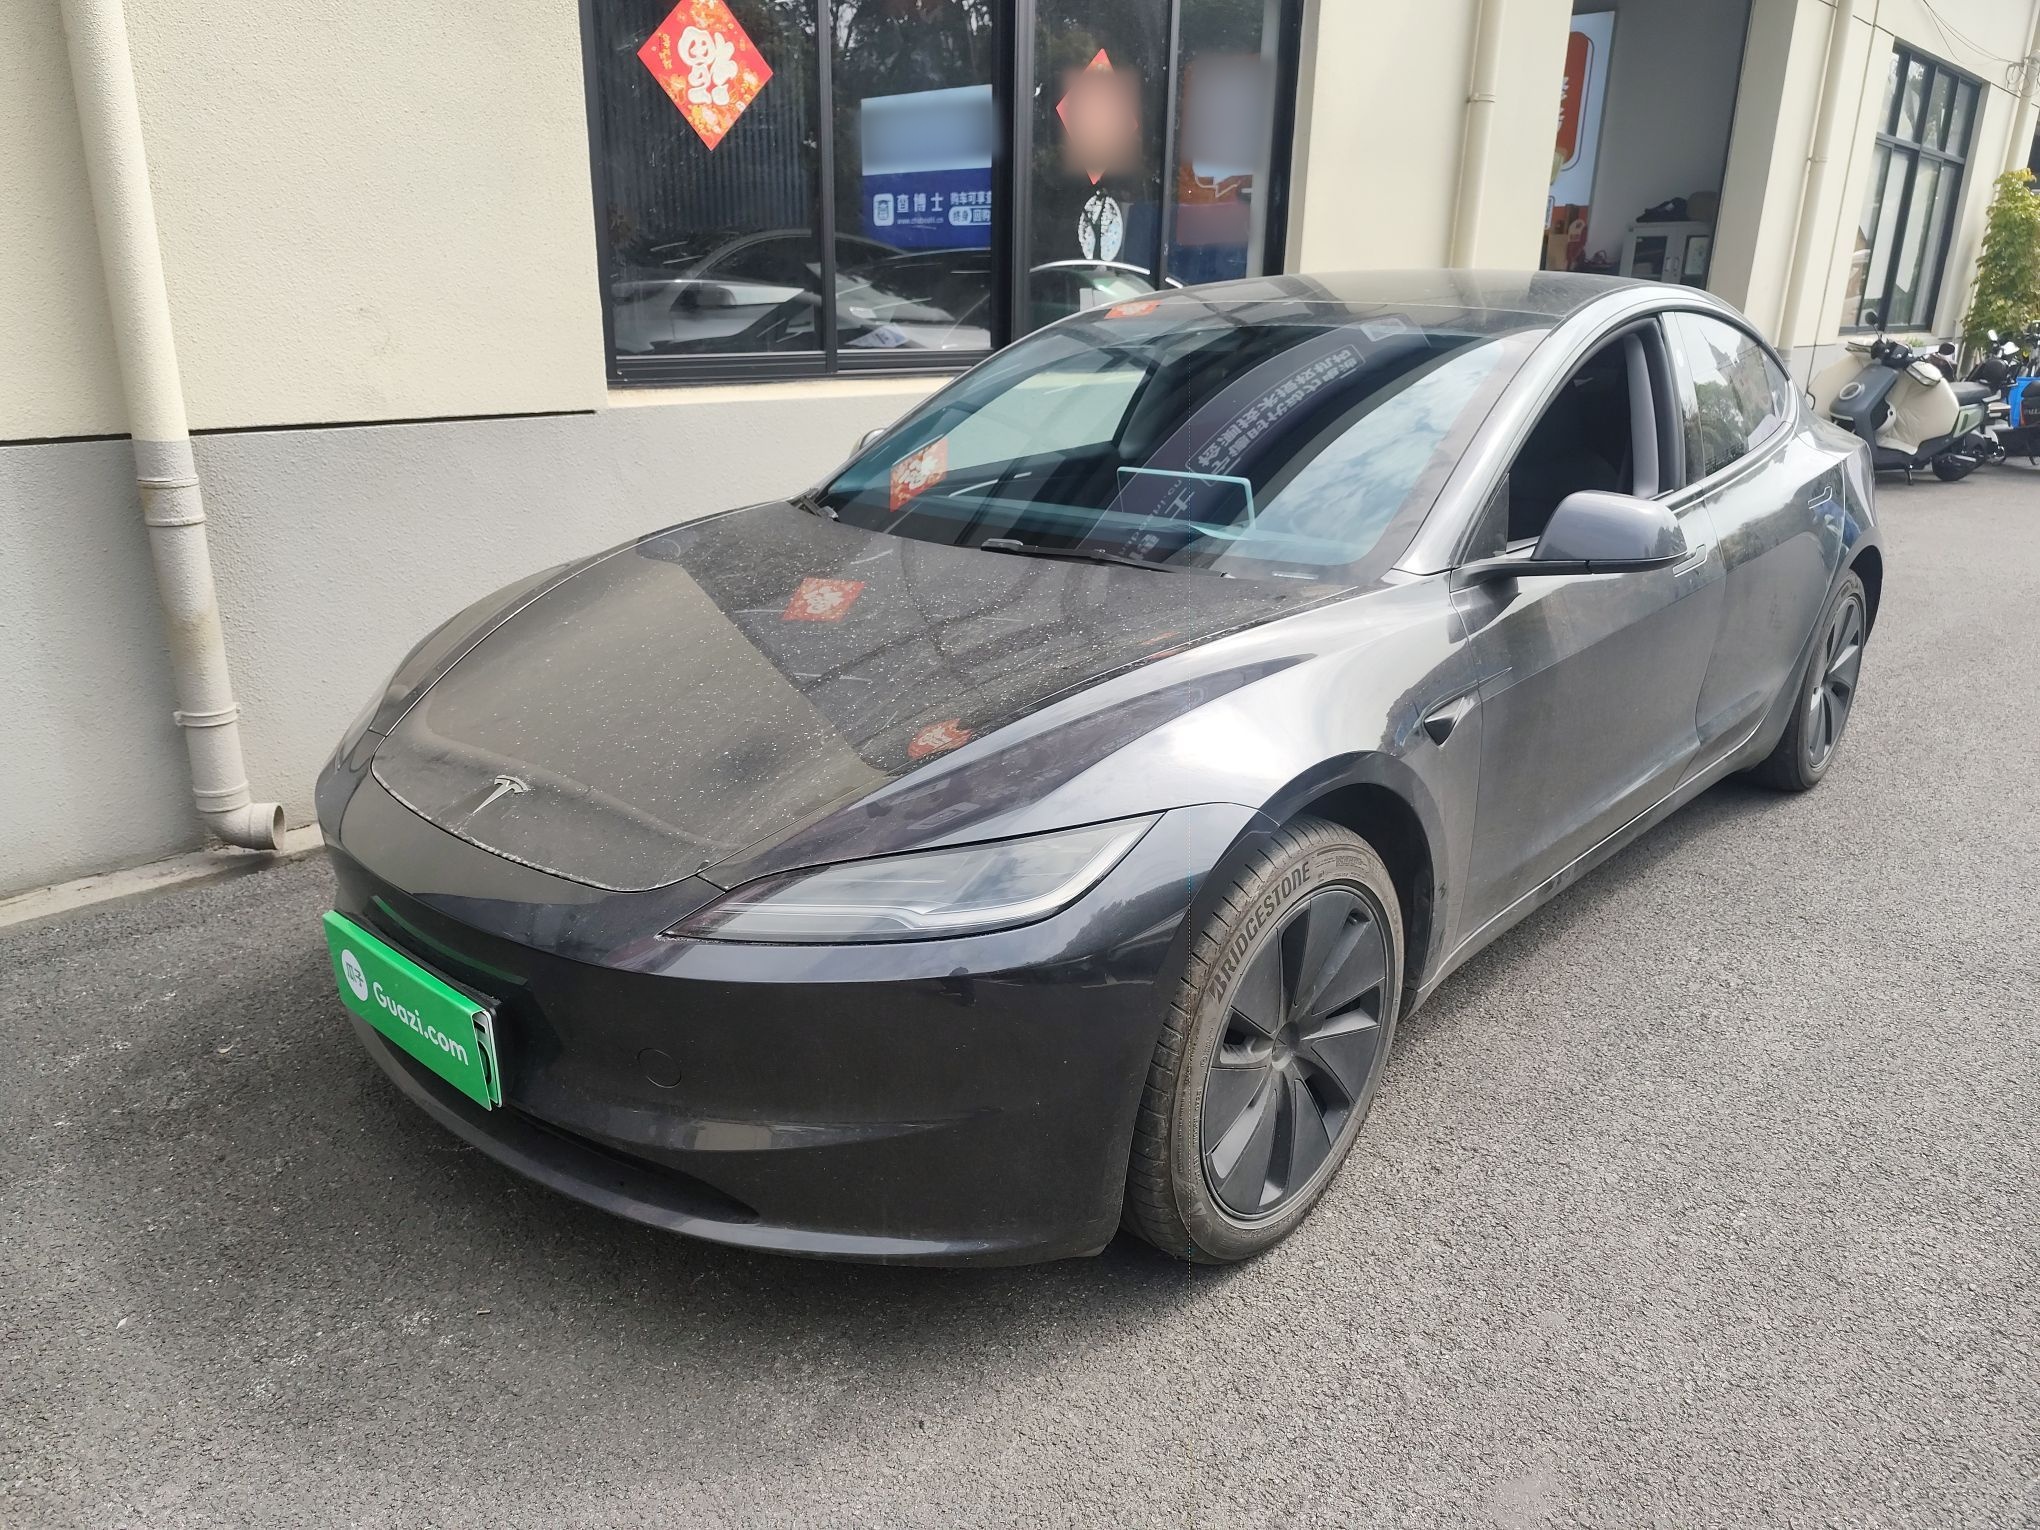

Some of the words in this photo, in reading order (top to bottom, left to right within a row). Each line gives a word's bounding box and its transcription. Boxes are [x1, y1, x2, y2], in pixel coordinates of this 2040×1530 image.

[677, 26, 738, 106] 福
[896, 192, 945, 213] 查博士
[1208, 861, 1312, 1004] BRIDGESTONE
[345, 960, 364, 988] 瓜子
[372, 981, 469, 1066] Guazi.com
